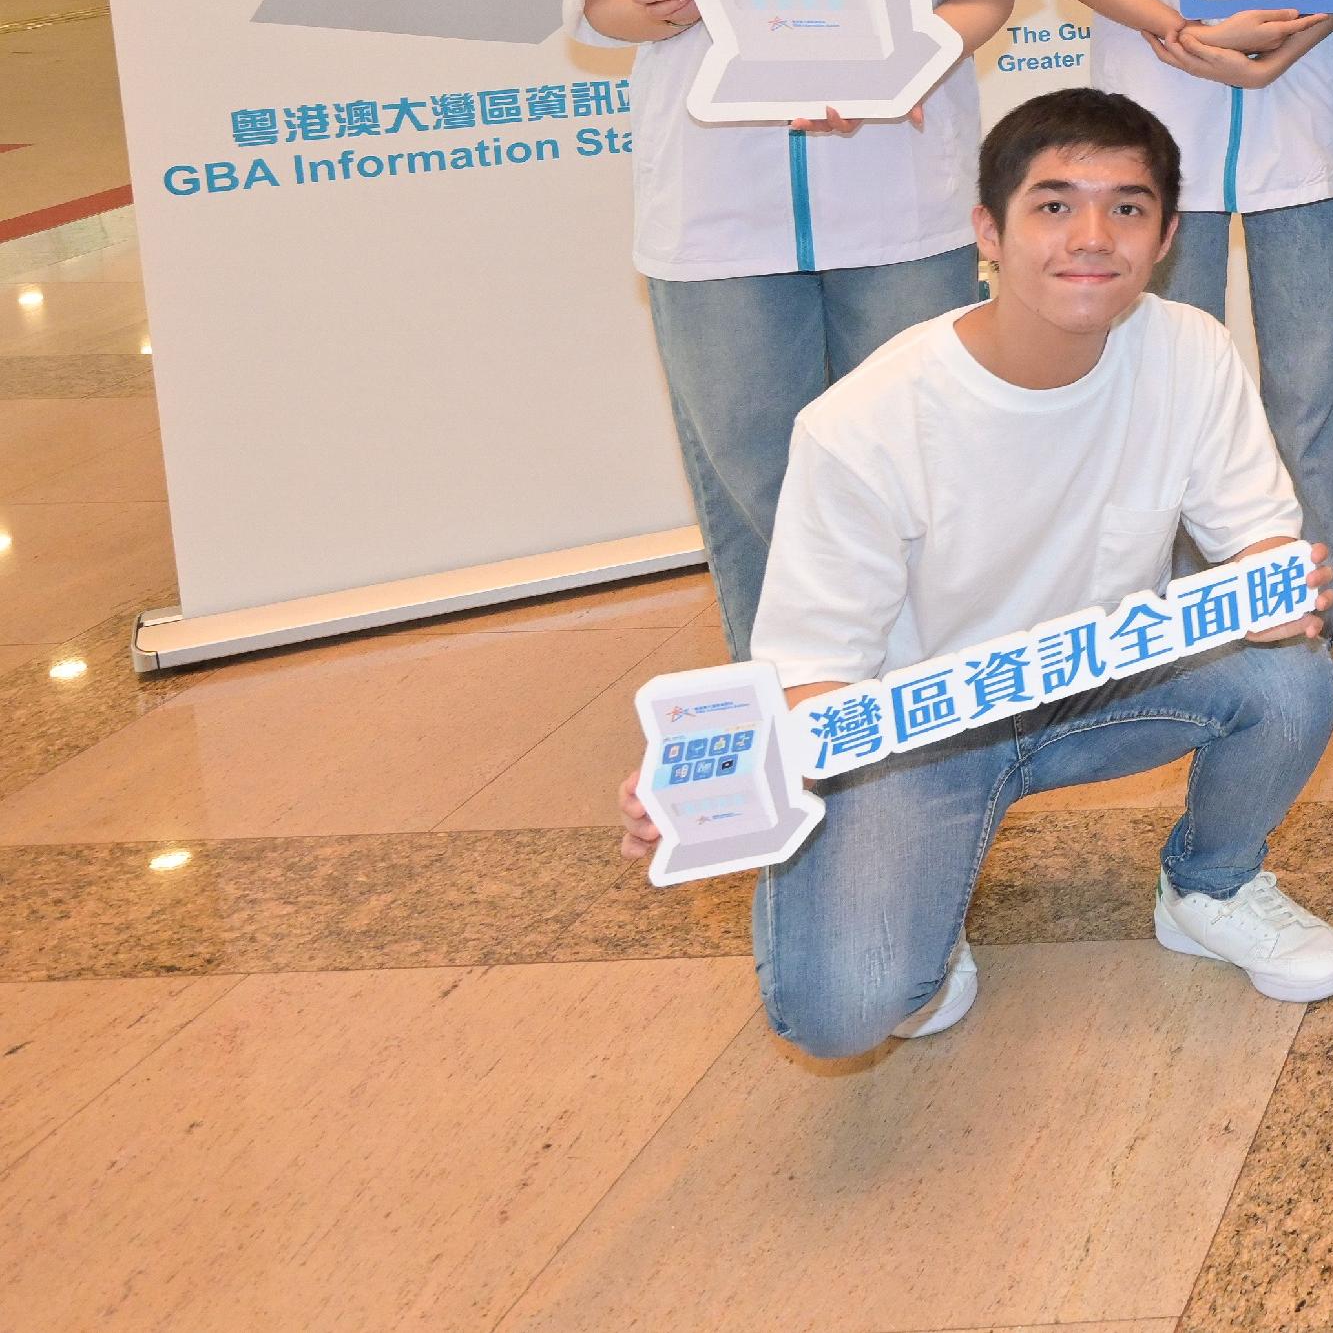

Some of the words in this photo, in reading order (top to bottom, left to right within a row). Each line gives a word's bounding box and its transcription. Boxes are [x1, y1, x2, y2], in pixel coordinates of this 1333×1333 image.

[1007, 27, 1050, 44] The
[1059, 24, 1091, 41] Gu
[998, 52, 1084, 72] Greater
[163, 158, 280, 197] GBA
[294, 137, 560, 184] Information
[809, 554, 1309, 770] 灣區資訊全面睇
